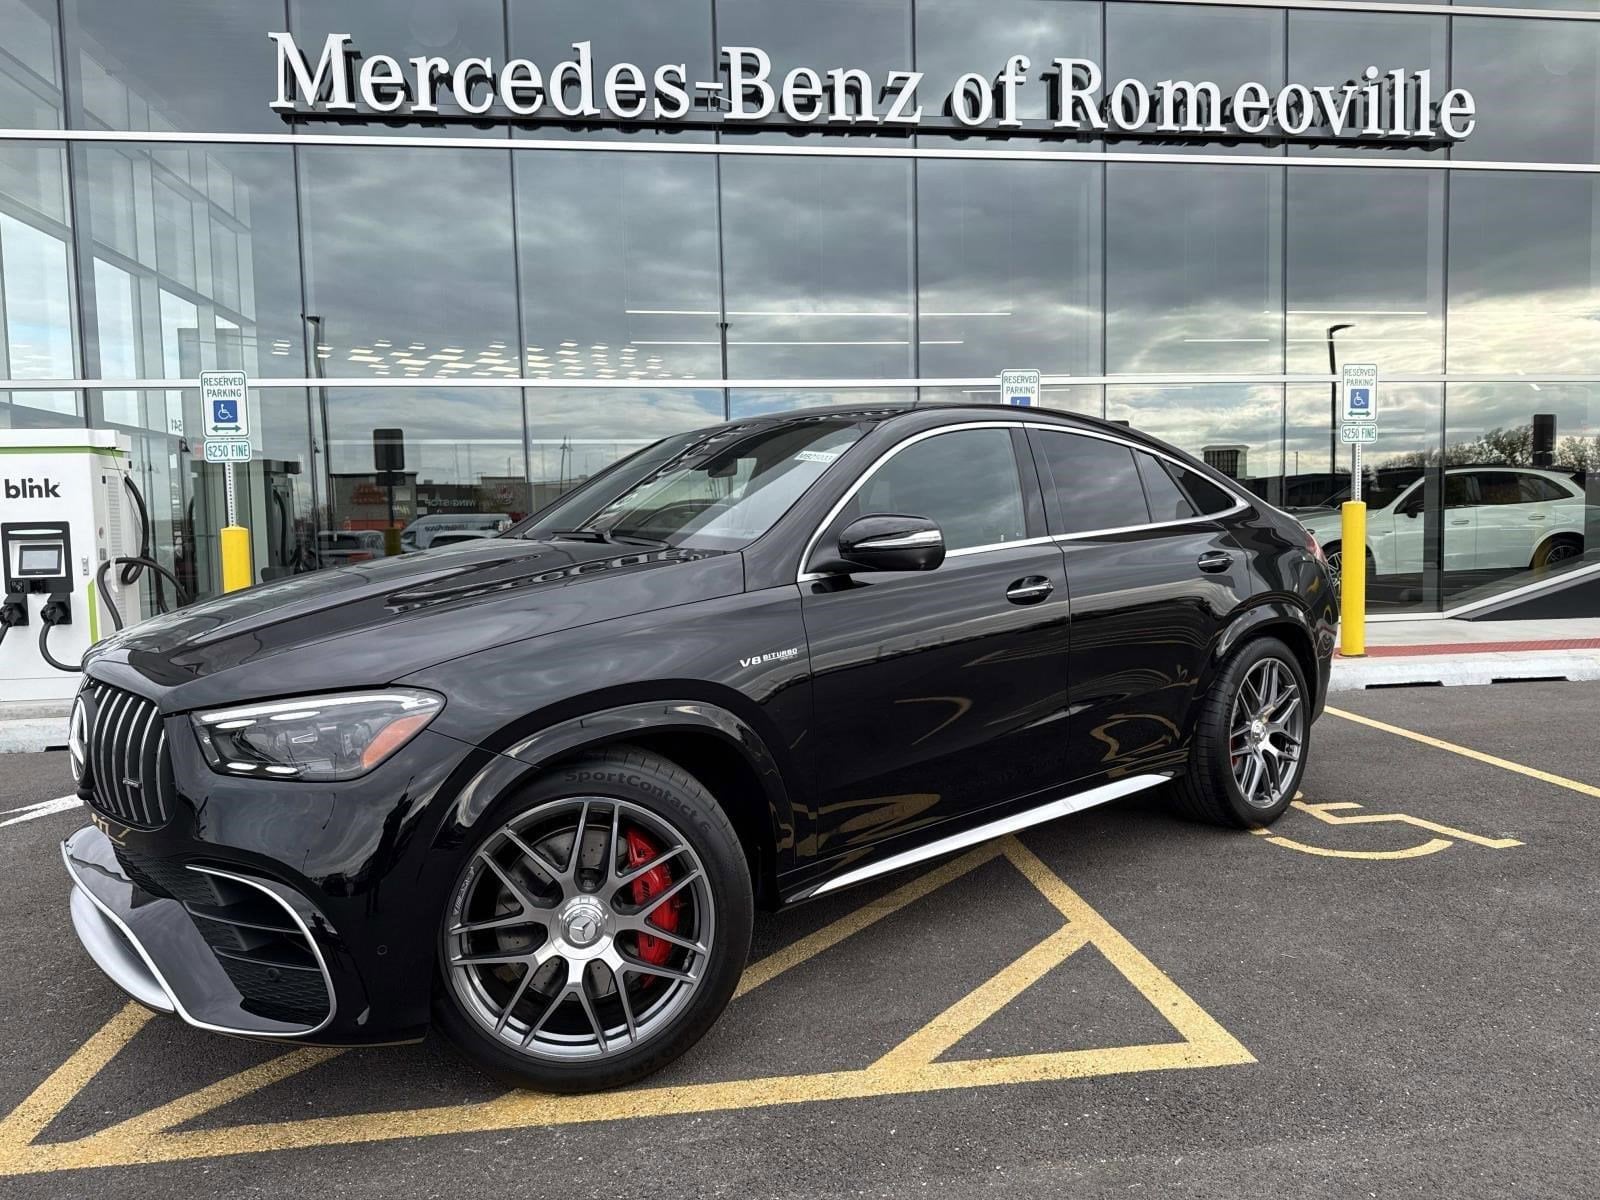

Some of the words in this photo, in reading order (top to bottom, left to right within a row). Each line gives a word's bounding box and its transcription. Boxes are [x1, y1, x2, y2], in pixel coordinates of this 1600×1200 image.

[267, 31, 924, 126] Mercedes-Benz
[952, 54, 1031, 128] of
[1053, 57, 1477, 139] Romeoville
[1344, 368, 1376, 377] RESERVED
[203, 377, 243, 387] RESERVED
[1003, 375, 1038, 384] RESERVED
[1346, 378, 1374, 387] PARKING
[206, 388, 242, 398] PARKING
[1006, 386, 1036, 395] PARKING
[1343, 427, 1360, 439] $250
[1361, 427, 1376, 439] FINE
[207, 445, 229, 458] $250
[231, 444, 249, 457] FINE
[4, 477, 62, 499] blink
[739, 655, 762, 668] V8
[564, 770, 699, 819] SportContact
